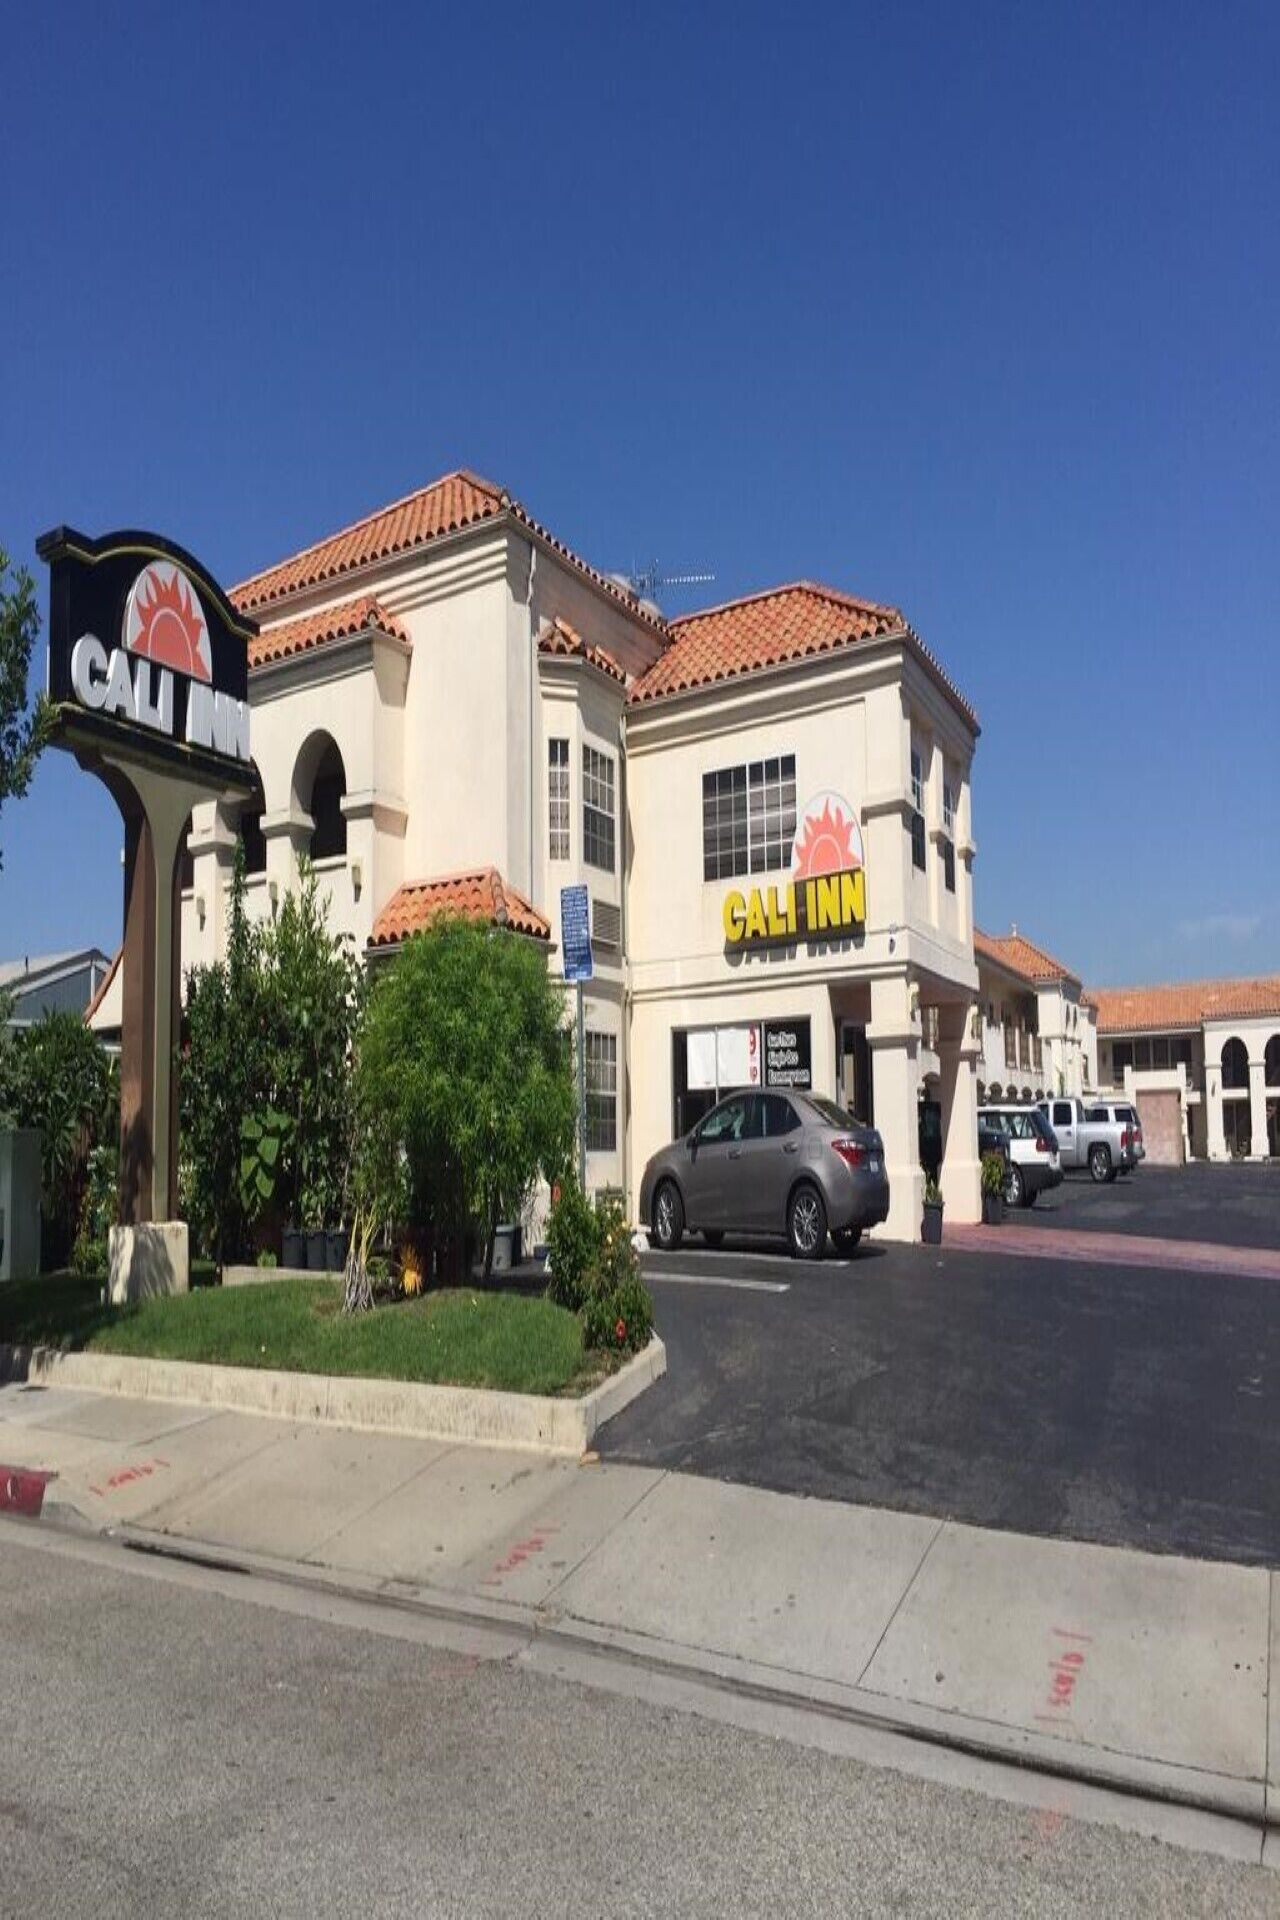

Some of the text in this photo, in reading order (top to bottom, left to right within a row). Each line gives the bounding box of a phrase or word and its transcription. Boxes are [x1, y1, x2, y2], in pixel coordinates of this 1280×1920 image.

[71, 633, 251, 762] CALI INN
[723, 871, 866, 942] CALI INN
